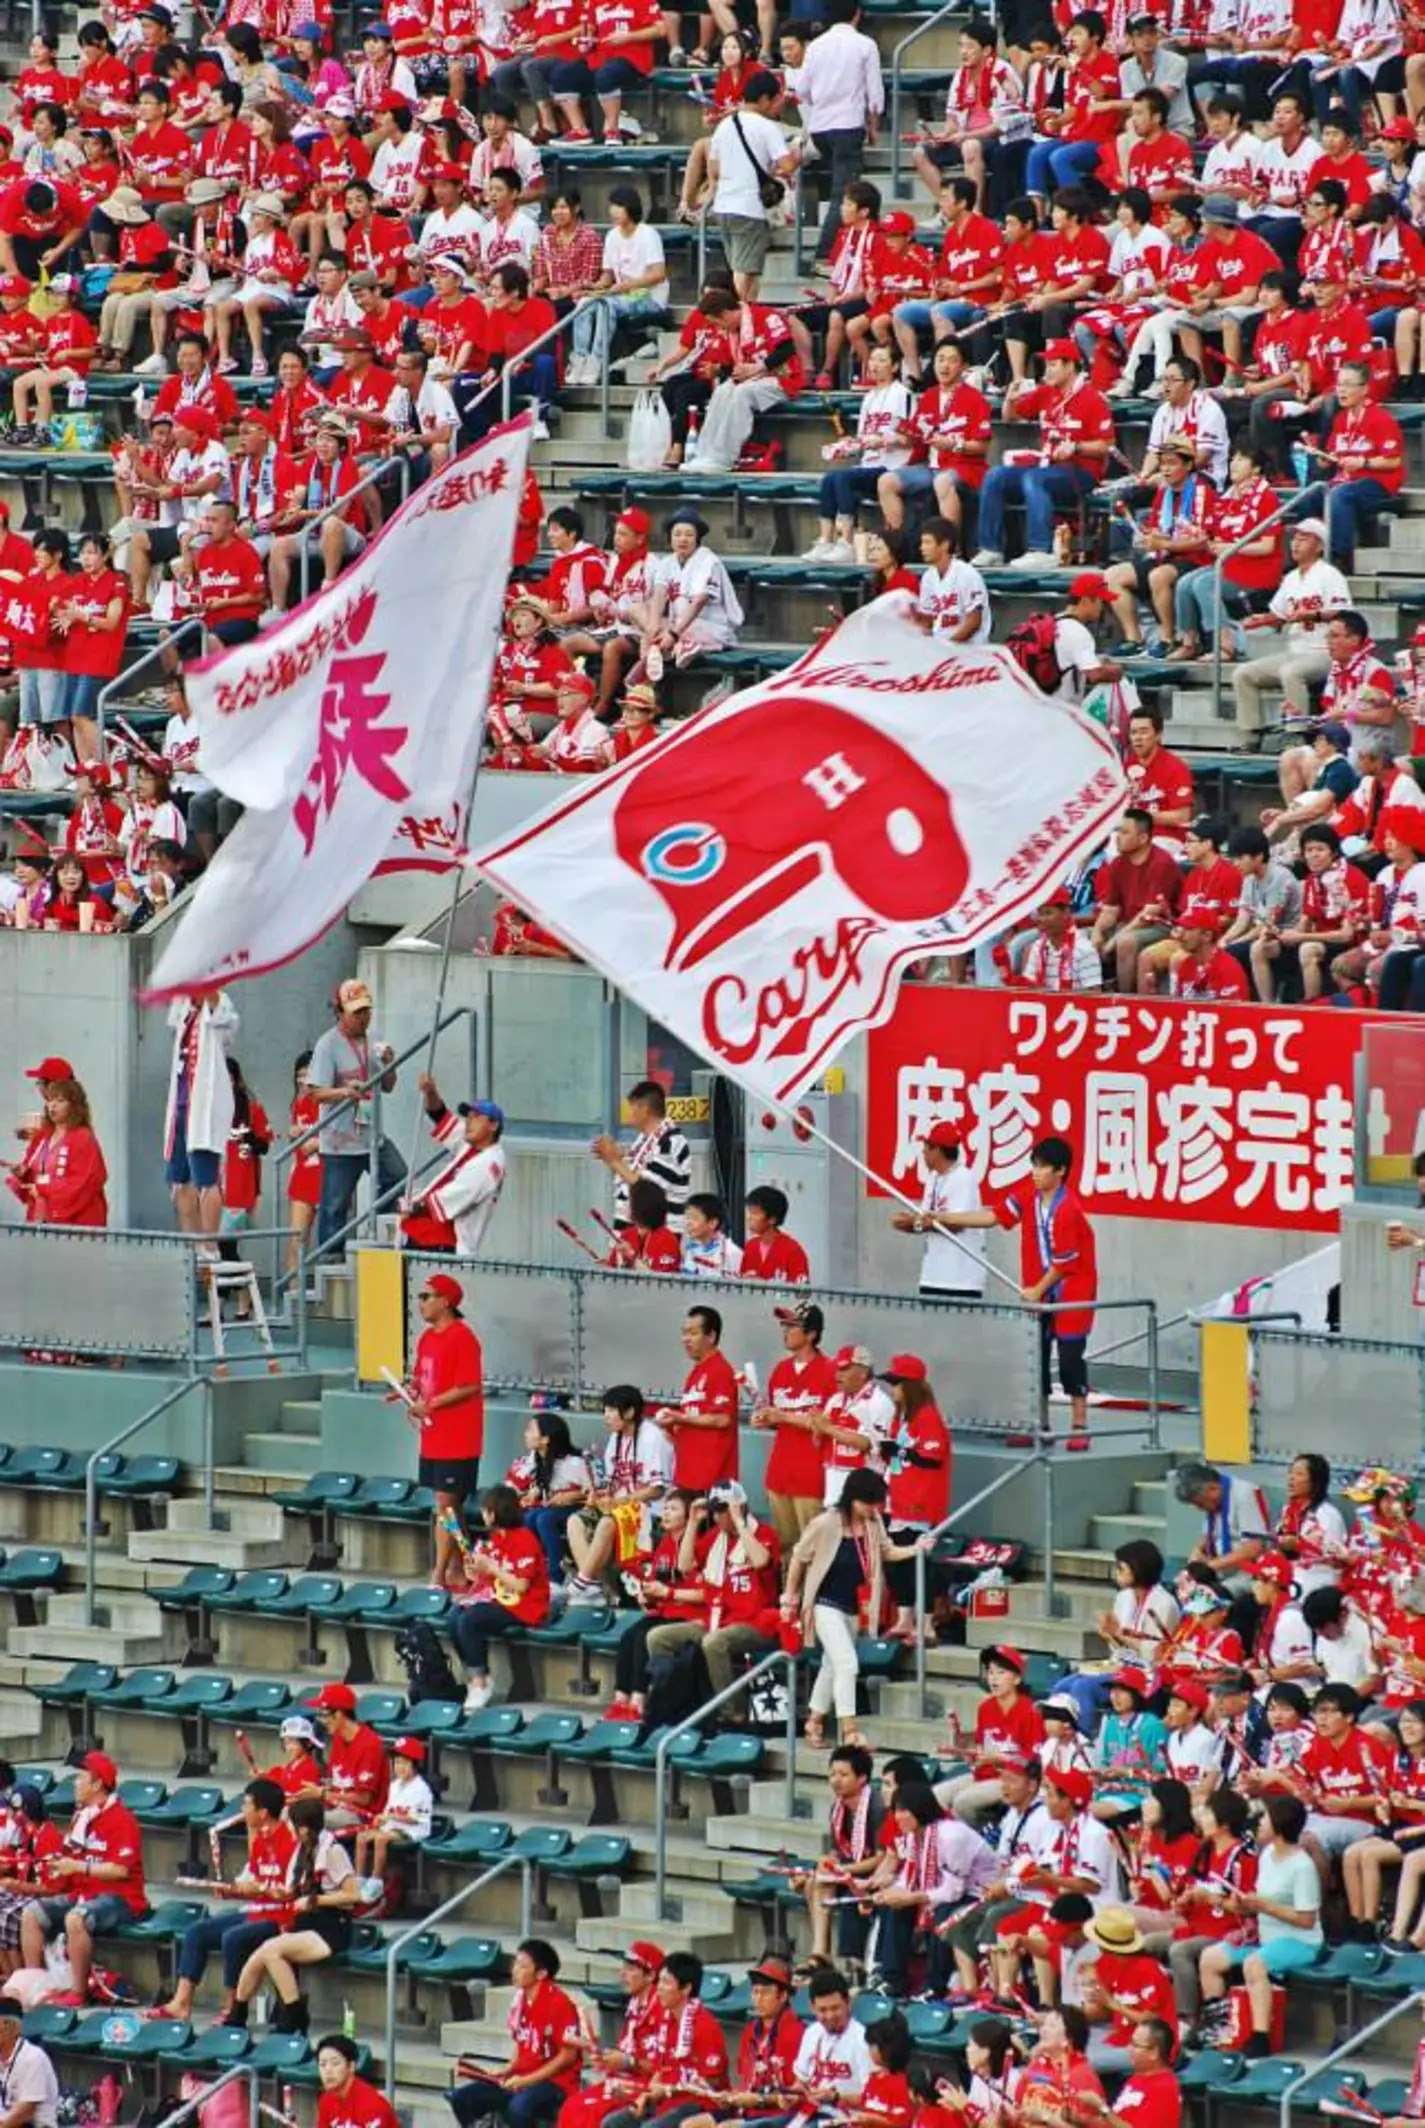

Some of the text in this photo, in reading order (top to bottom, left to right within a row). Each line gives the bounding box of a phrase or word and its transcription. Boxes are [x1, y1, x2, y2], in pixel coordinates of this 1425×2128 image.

[768, 656, 1001, 694] Hiroshima
[802, 752, 867, 811] H
[702, 917, 887, 1064] Carp
[1009, 1001, 1304, 1073] ワクチン打って
